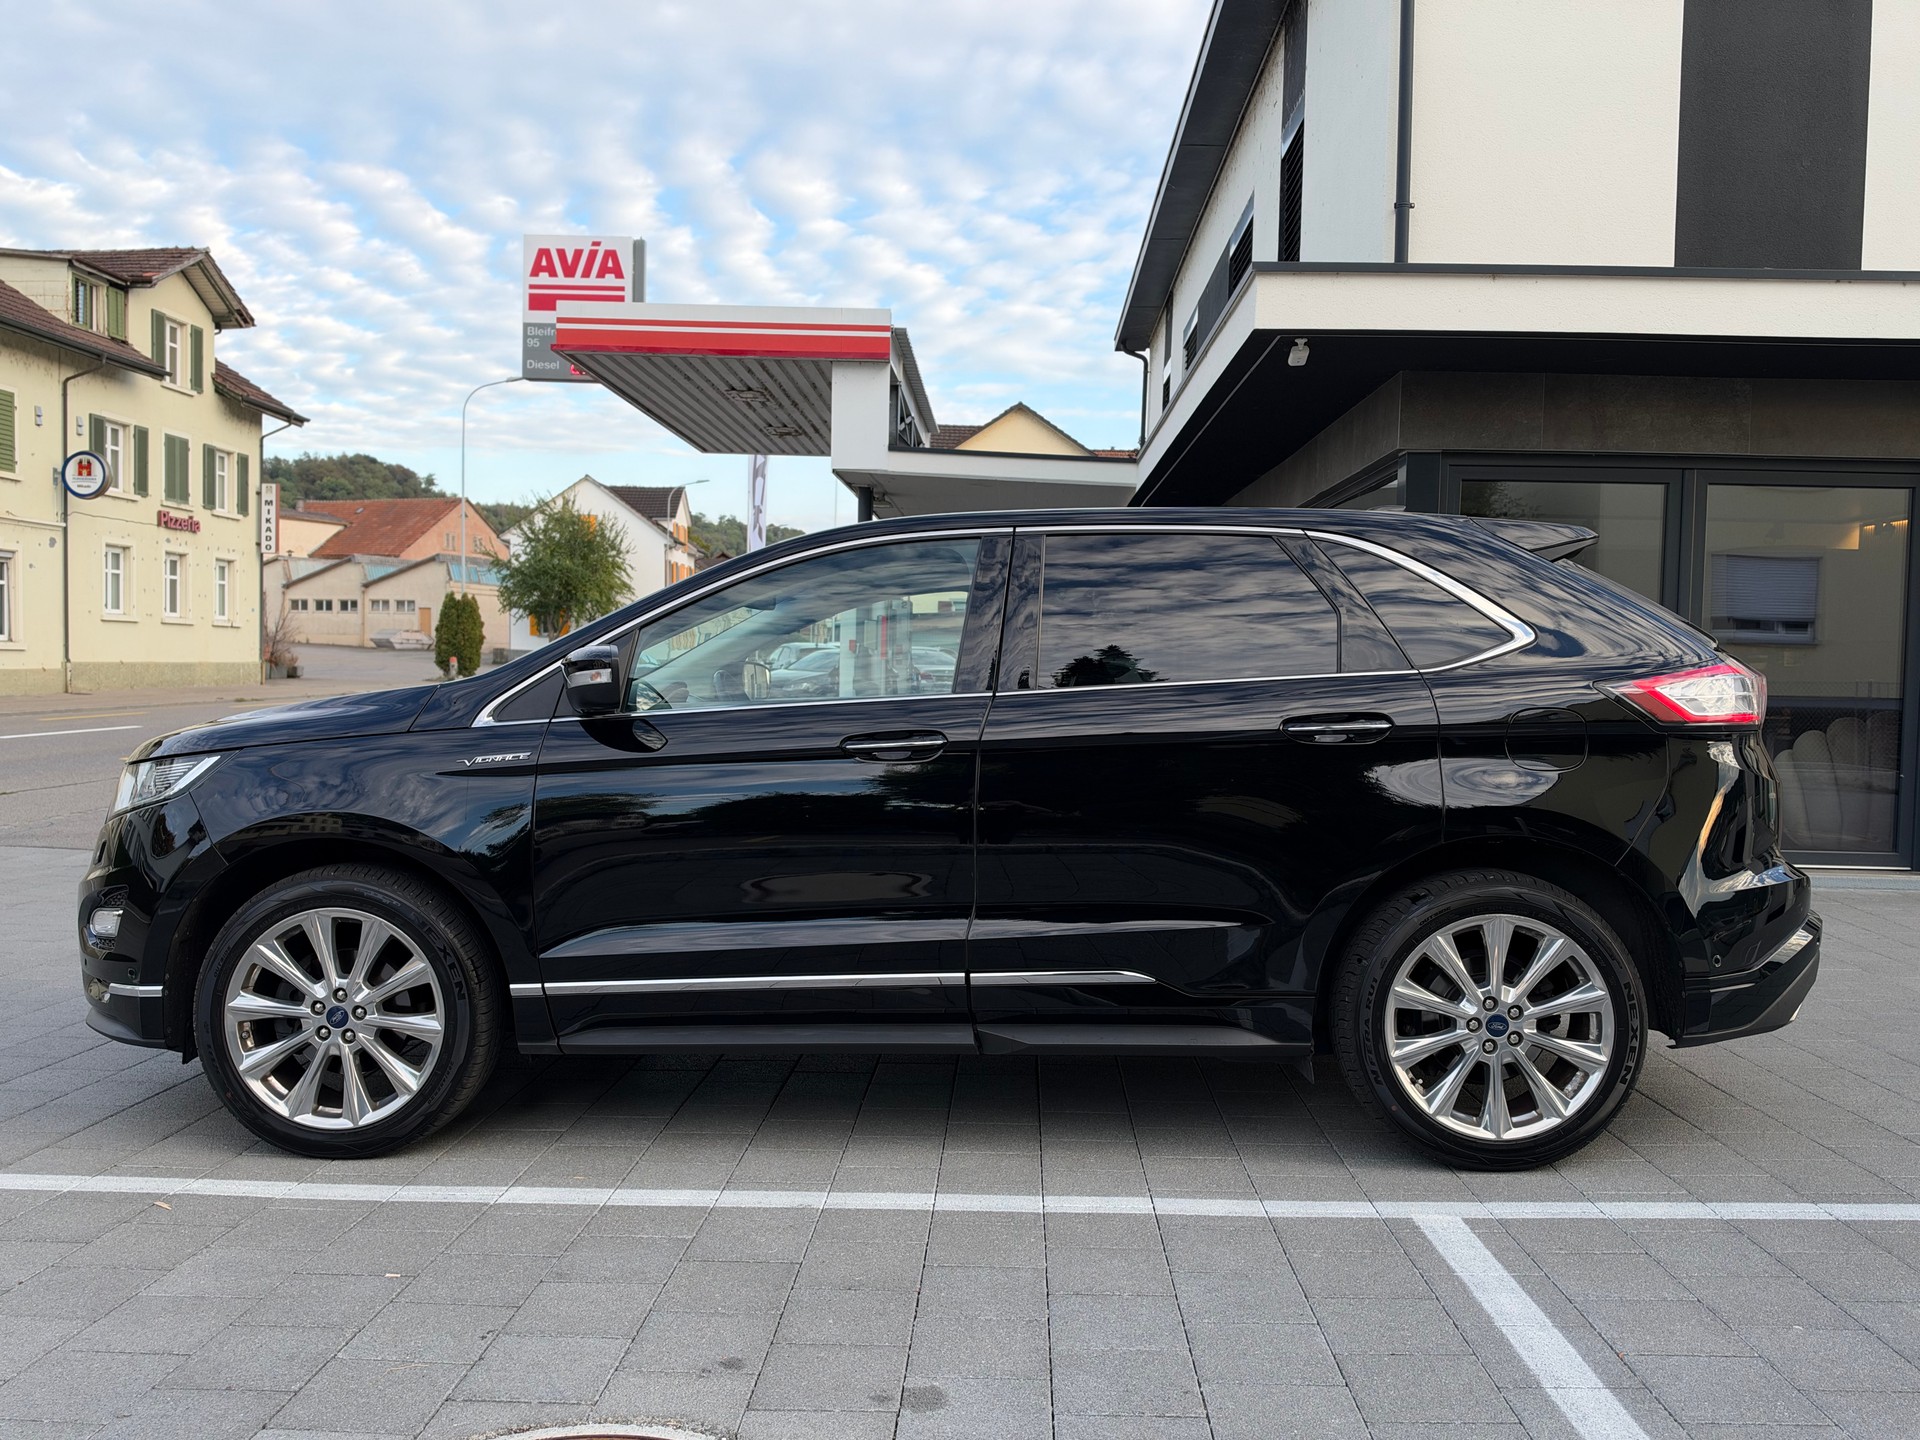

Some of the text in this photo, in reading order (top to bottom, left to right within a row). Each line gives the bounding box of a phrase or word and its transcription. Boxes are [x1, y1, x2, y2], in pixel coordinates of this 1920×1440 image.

[529, 241, 625, 279] AVIA
[526, 338, 540, 348] 95
[527, 326, 557, 337] Bleifr
[526, 360, 560, 370] Diesel
[157, 510, 202, 534] Pizzeria
[264, 499, 274, 551] MIKADO
[409, 911, 467, 1001] NEXEN
[1619, 981, 1639, 1085] NEXEN
